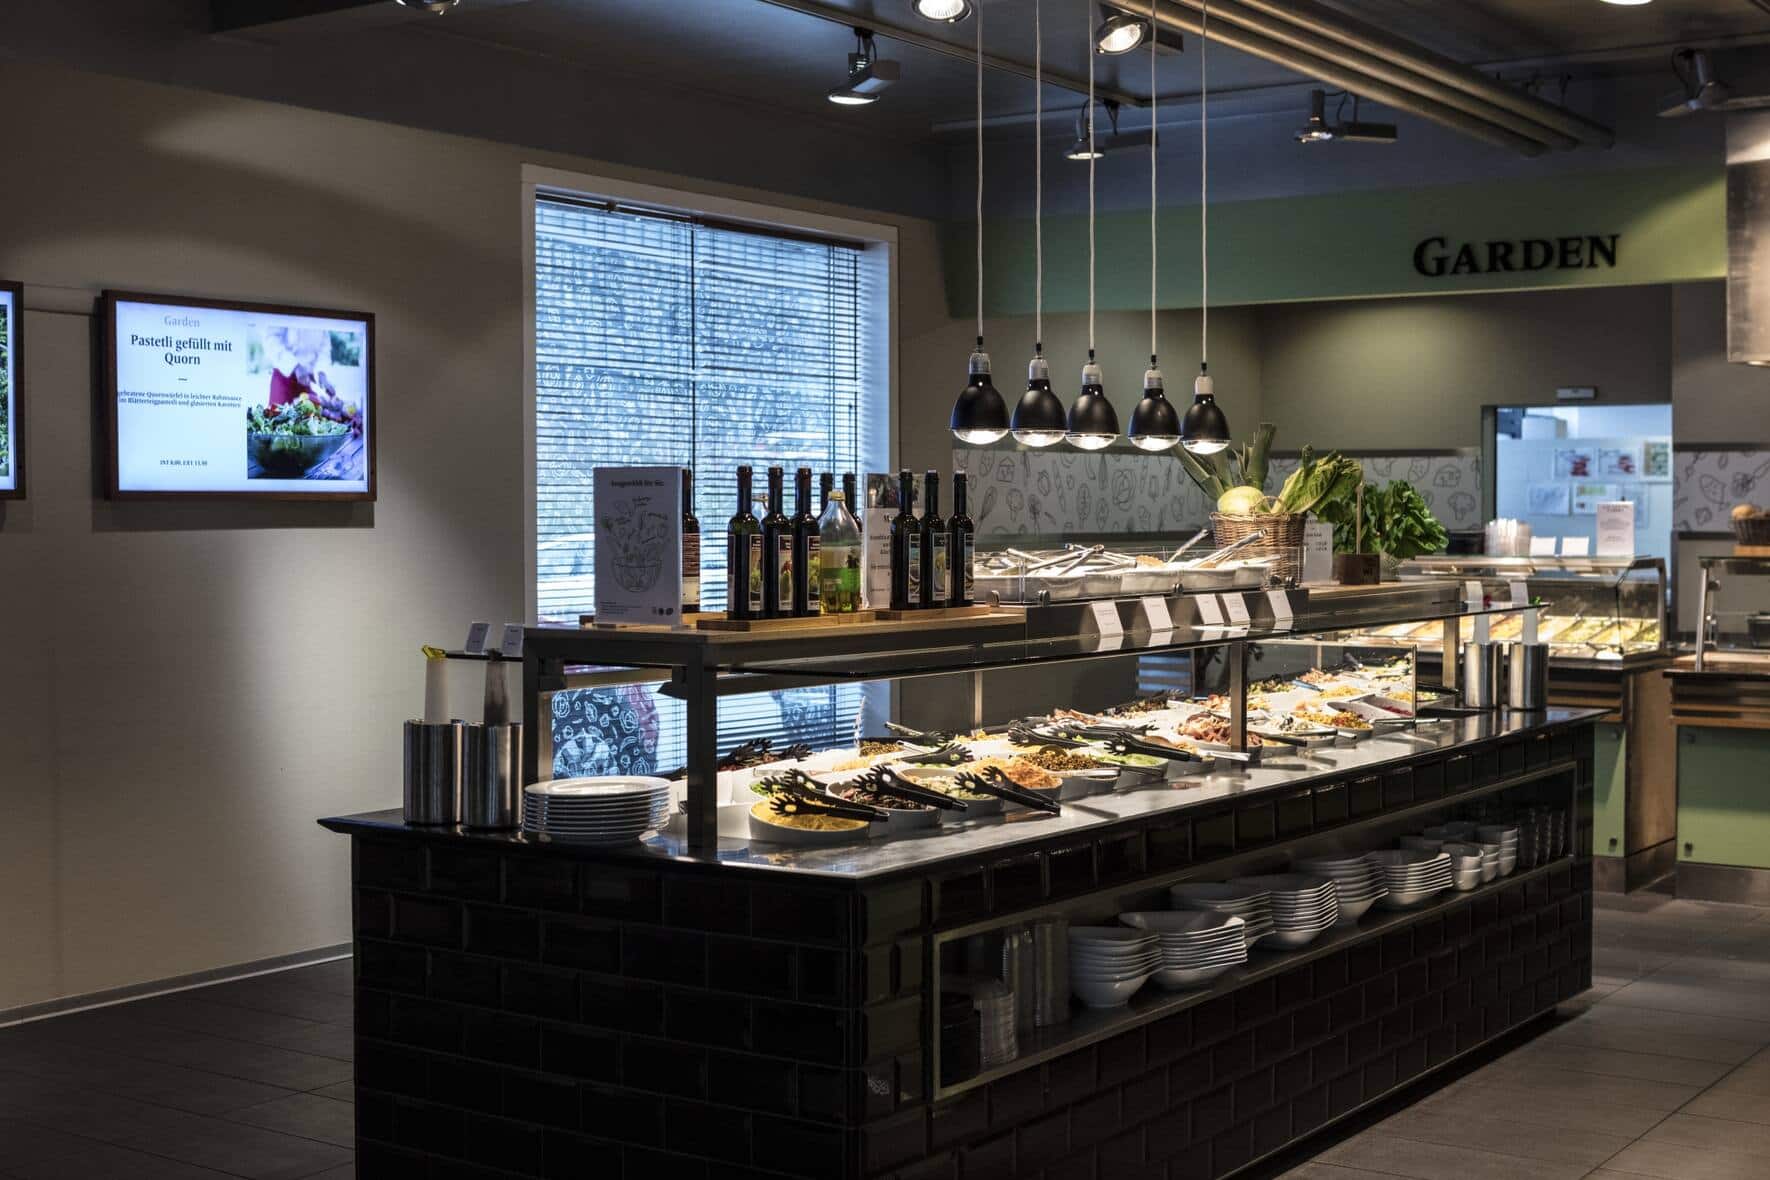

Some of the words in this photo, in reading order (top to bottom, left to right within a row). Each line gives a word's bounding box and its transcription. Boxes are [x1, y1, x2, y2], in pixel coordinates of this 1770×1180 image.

[1413, 234, 1620, 277] GARDEN
[164, 315, 200, 328] Garden
[131, 334, 173, 347] Pastetli
[175, 337, 211, 352] gefüllt
[213, 340, 232, 352] mit
[164, 352, 201, 366] Quorn
